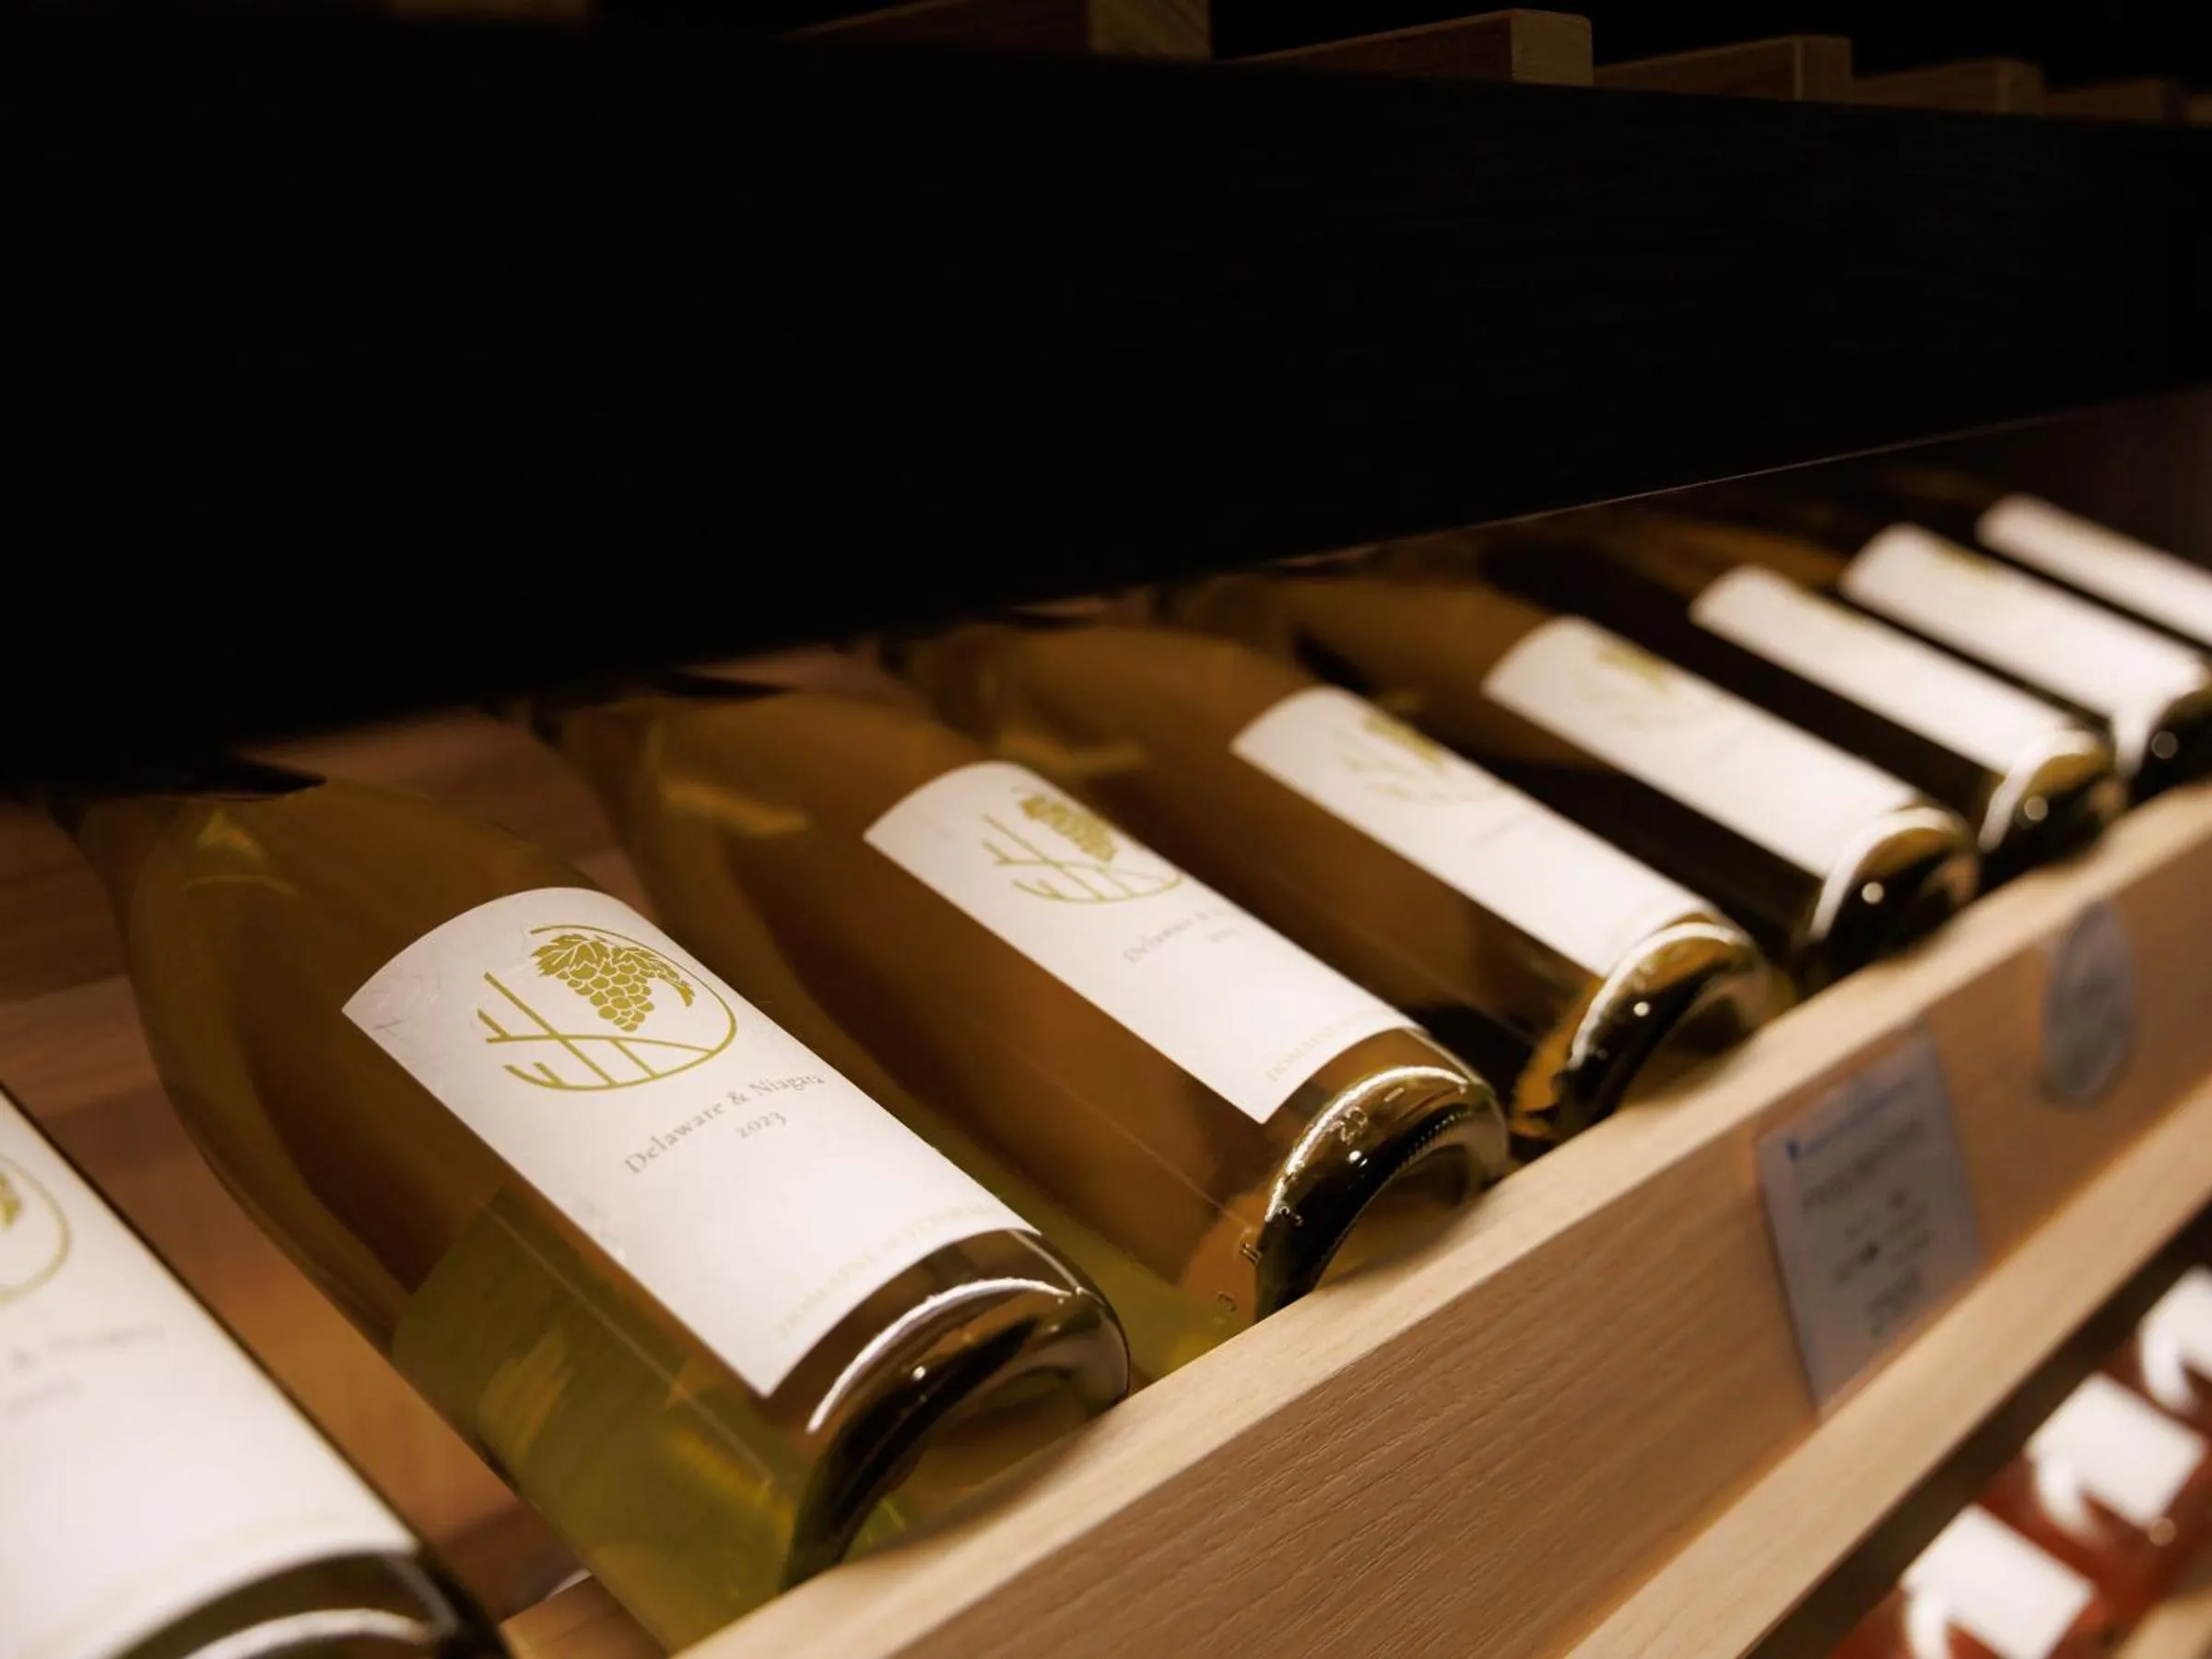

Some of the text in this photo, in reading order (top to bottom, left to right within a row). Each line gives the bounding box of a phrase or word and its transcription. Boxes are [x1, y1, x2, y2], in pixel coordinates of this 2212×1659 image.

[624, 1101, 726, 1174] Delaware
[727, 1089, 751, 1106] &
[736, 1111, 788, 1139] 2023
